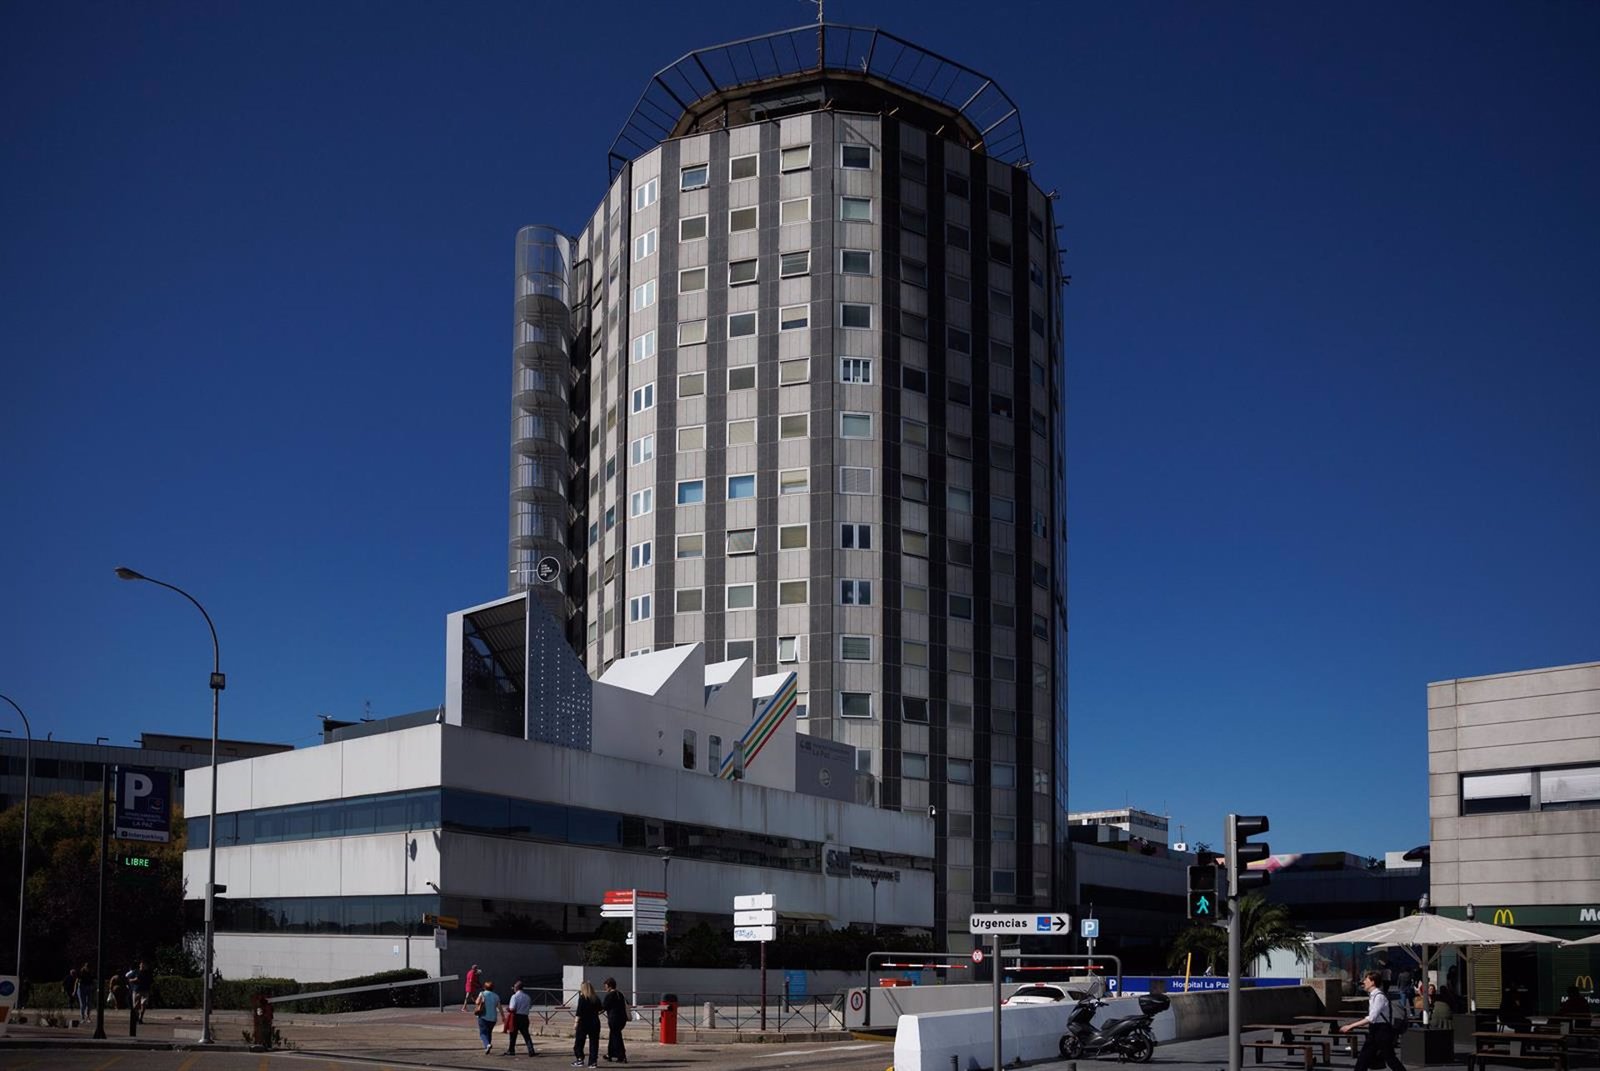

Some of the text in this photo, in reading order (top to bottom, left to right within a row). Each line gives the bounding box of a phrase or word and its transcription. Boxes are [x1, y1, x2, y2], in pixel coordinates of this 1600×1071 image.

[124, 772, 153, 810] P
[125, 857, 149, 867] LIBRE
[972, 918, 1028, 930] Urgencias
[1084, 921, 1095, 935] P
[1109, 979, 1117, 990] P
[1204, 981, 1214, 989] La
[1216, 981, 1230, 989] Paz
